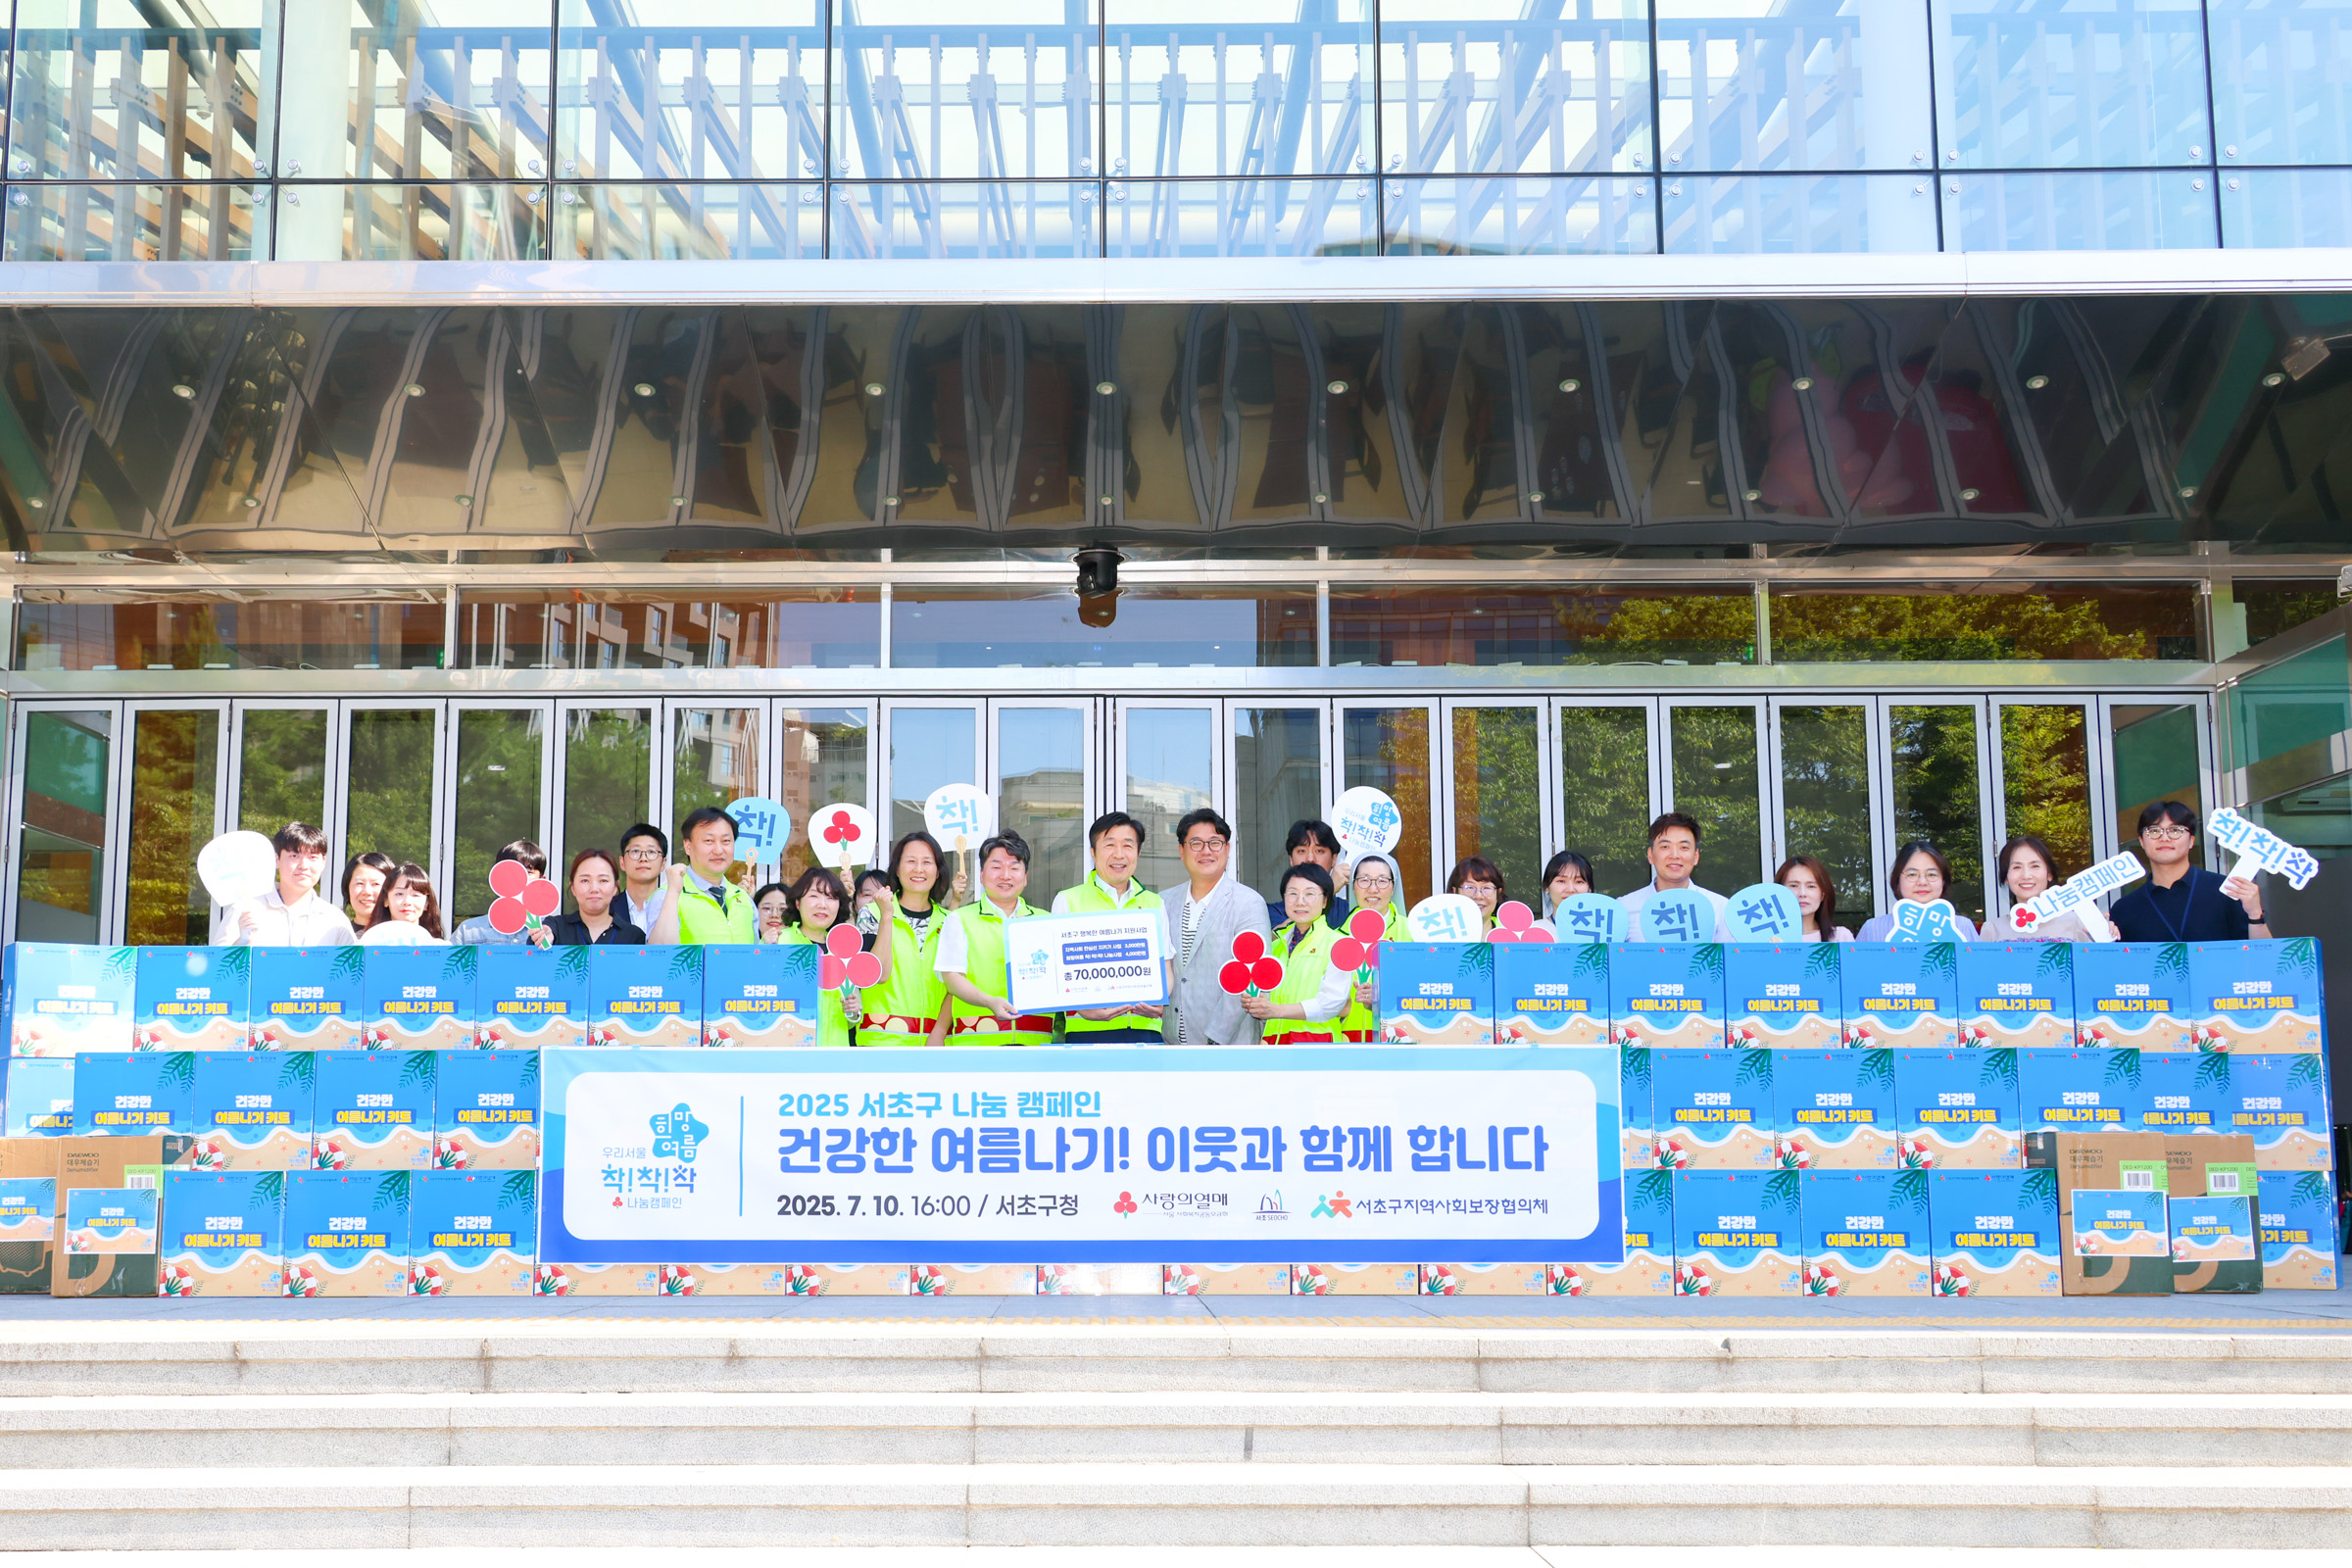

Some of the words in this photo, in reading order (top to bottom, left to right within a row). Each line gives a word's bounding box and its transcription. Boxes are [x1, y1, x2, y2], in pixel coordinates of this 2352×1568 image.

[936, 795, 979, 835] 착!
[735, 805, 776, 848] 착!
[2034, 856, 2140, 917] 나눔캠페인
[1738, 894, 1789, 935] 착!
[1417, 906, 1468, 940] 착!
[1569, 902, 1613, 943] 착!
[1651, 902, 1699, 942] 착!
[290, 987, 324, 999] 건강한
[403, 986, 436, 998] 건강한
[515, 987, 549, 998] 건강한
[629, 986, 662, 998] 건강한
[744, 985, 777, 997] 건강한
[1419, 983, 1453, 995] 건강한
[1535, 984, 1568, 996] 건강한
[1650, 984, 1684, 996] 건강한
[1766, 985, 1800, 996] 건강한
[1882, 984, 1916, 995] 건강한
[1998, 984, 2033, 995] 건강한
[2116, 984, 2149, 996] 건강한
[2233, 981, 2272, 994] 건강한
[176, 988, 211, 1000] 건강한
[157, 1003, 203, 1014] 여름나기
[206, 1003, 228, 1014] 키트
[270, 1002, 317, 1013] 여름나기
[319, 1002, 342, 1013] 키트
[384, 1002, 429, 1012] 여름나기
[432, 1002, 455, 1012] 키트
[497, 1002, 542, 1012] 여름나기
[545, 1002, 566, 1012] 키트
[611, 1001, 656, 1012] 여름나기
[659, 1001, 681, 1012] 키트
[725, 1000, 770, 1011] 여름나기
[773, 1000, 796, 1011] 키트
[1401, 998, 1446, 1009] 여름나기
[1449, 998, 1472, 1009] 키트
[1516, 999, 1562, 1010] 여름나기
[1565, 999, 1588, 1010] 키트
[1632, 999, 1677, 1010] 여름나기
[1681, 999, 1703, 1010] 키트
[1748, 1000, 1793, 1010] 여름나기
[1797, 1000, 1820, 1010] 키트
[1864, 999, 1910, 1009] 여름나기
[1913, 999, 1936, 1009] 키트
[1980, 999, 2027, 1009] 여름나기
[2030, 999, 2052, 1009] 키트
[2097, 999, 2143, 1010] 여름나기
[2147, 999, 2170, 1010] 키트
[2214, 996, 2265, 1009] 여름나기
[2269, 996, 2295, 1009] 키트
[116, 1096, 152, 1108] 건강한
[235, 1096, 271, 1107] 건강한
[357, 1095, 393, 1106] 건강한
[478, 1094, 514, 1105] 건강한
[778, 1093, 849, 1117] 2025
[858, 1091, 944, 1118] 서초구
[953, 1091, 1007, 1118] 나눔
[1017, 1091, 1101, 1118] 캠페인
[1694, 1093, 1731, 1105] 건강한
[1816, 1094, 1852, 1105] 건강한
[1938, 1094, 1976, 1105] 건강한
[2063, 1093, 2099, 1104] 건강한
[2154, 1096, 2190, 1108] 건강한
[2242, 1097, 2282, 1109] 건강한
[95, 1111, 143, 1124] 여름나기
[147, 1111, 171, 1124] 키트
[216, 1111, 264, 1123] 여름나기
[267, 1111, 290, 1123] 키트
[336, 1110, 385, 1122] 여름나기
[388, 1110, 412, 1122] 키트
[458, 1109, 506, 1122] 여름나기
[510, 1109, 533, 1122] 키트
[1676, 1108, 1724, 1121] 여름나기
[1728, 1108, 1752, 1121] 키트
[1797, 1109, 1845, 1122] 여름나기
[1849, 1109, 1874, 1122] 키트
[1920, 1109, 1969, 1122] 여름나기
[1973, 1109, 1997, 1122] 키트
[2044, 1108, 2093, 1121] 여름나기
[2096, 1108, 2122, 1121] 키트
[2187, 1112, 2211, 1125] 키트
[2278, 1113, 2305, 1125] 키트
[655, 1111, 692, 1139] 희망
[603, 1147, 647, 1158] 우리서울
[662, 1135, 698, 1159] 여름
[778, 1126, 917, 1174] 건강한
[932, 1125, 1130, 1174] 여름나기!
[1148, 1125, 1288, 1173] 이웃과
[1299, 1125, 1393, 1173] 함께
[1407, 1125, 1550, 1173] 합니다
[627, 1197, 682, 1209] 나눔캠페인
[777, 1194, 841, 1217] 2025.
[848, 1195, 866, 1217] 7.
[873, 1195, 905, 1217] 10.
[911, 1195, 970, 1217] 16:00
[978, 1193, 989, 1218] /
[996, 1194, 1079, 1217] 서초구청
[1142, 1192, 1228, 1211] 사랑의열매
[1355, 1198, 1548, 1215] 서초구지역사회보장협의체
[206, 1217, 243, 1230] 건강한
[329, 1217, 367, 1230] 건강한
[455, 1216, 492, 1229] 건강한
[1718, 1216, 1756, 1229] 건강한
[1846, 1216, 1884, 1229] 건강한
[1976, 1216, 2014, 1229] 건강한
[184, 1234, 234, 1247] 여름나기
[238, 1234, 263, 1247] 키트
[308, 1234, 358, 1247] 여름나기
[362, 1234, 386, 1247] 키트
[433, 1233, 483, 1246] 여름나기
[487, 1233, 512, 1246] 키트
[1698, 1233, 1749, 1246] 여름나기
[1752, 1233, 1778, 1246] 키트
[1826, 1233, 1877, 1246] 여름나기
[1881, 1233, 1906, 1246] 키트
[1955, 1233, 2007, 1246] 여름나기
[2010, 1233, 2035, 1246] 키트
[2282, 1230, 2309, 1243] 키트
